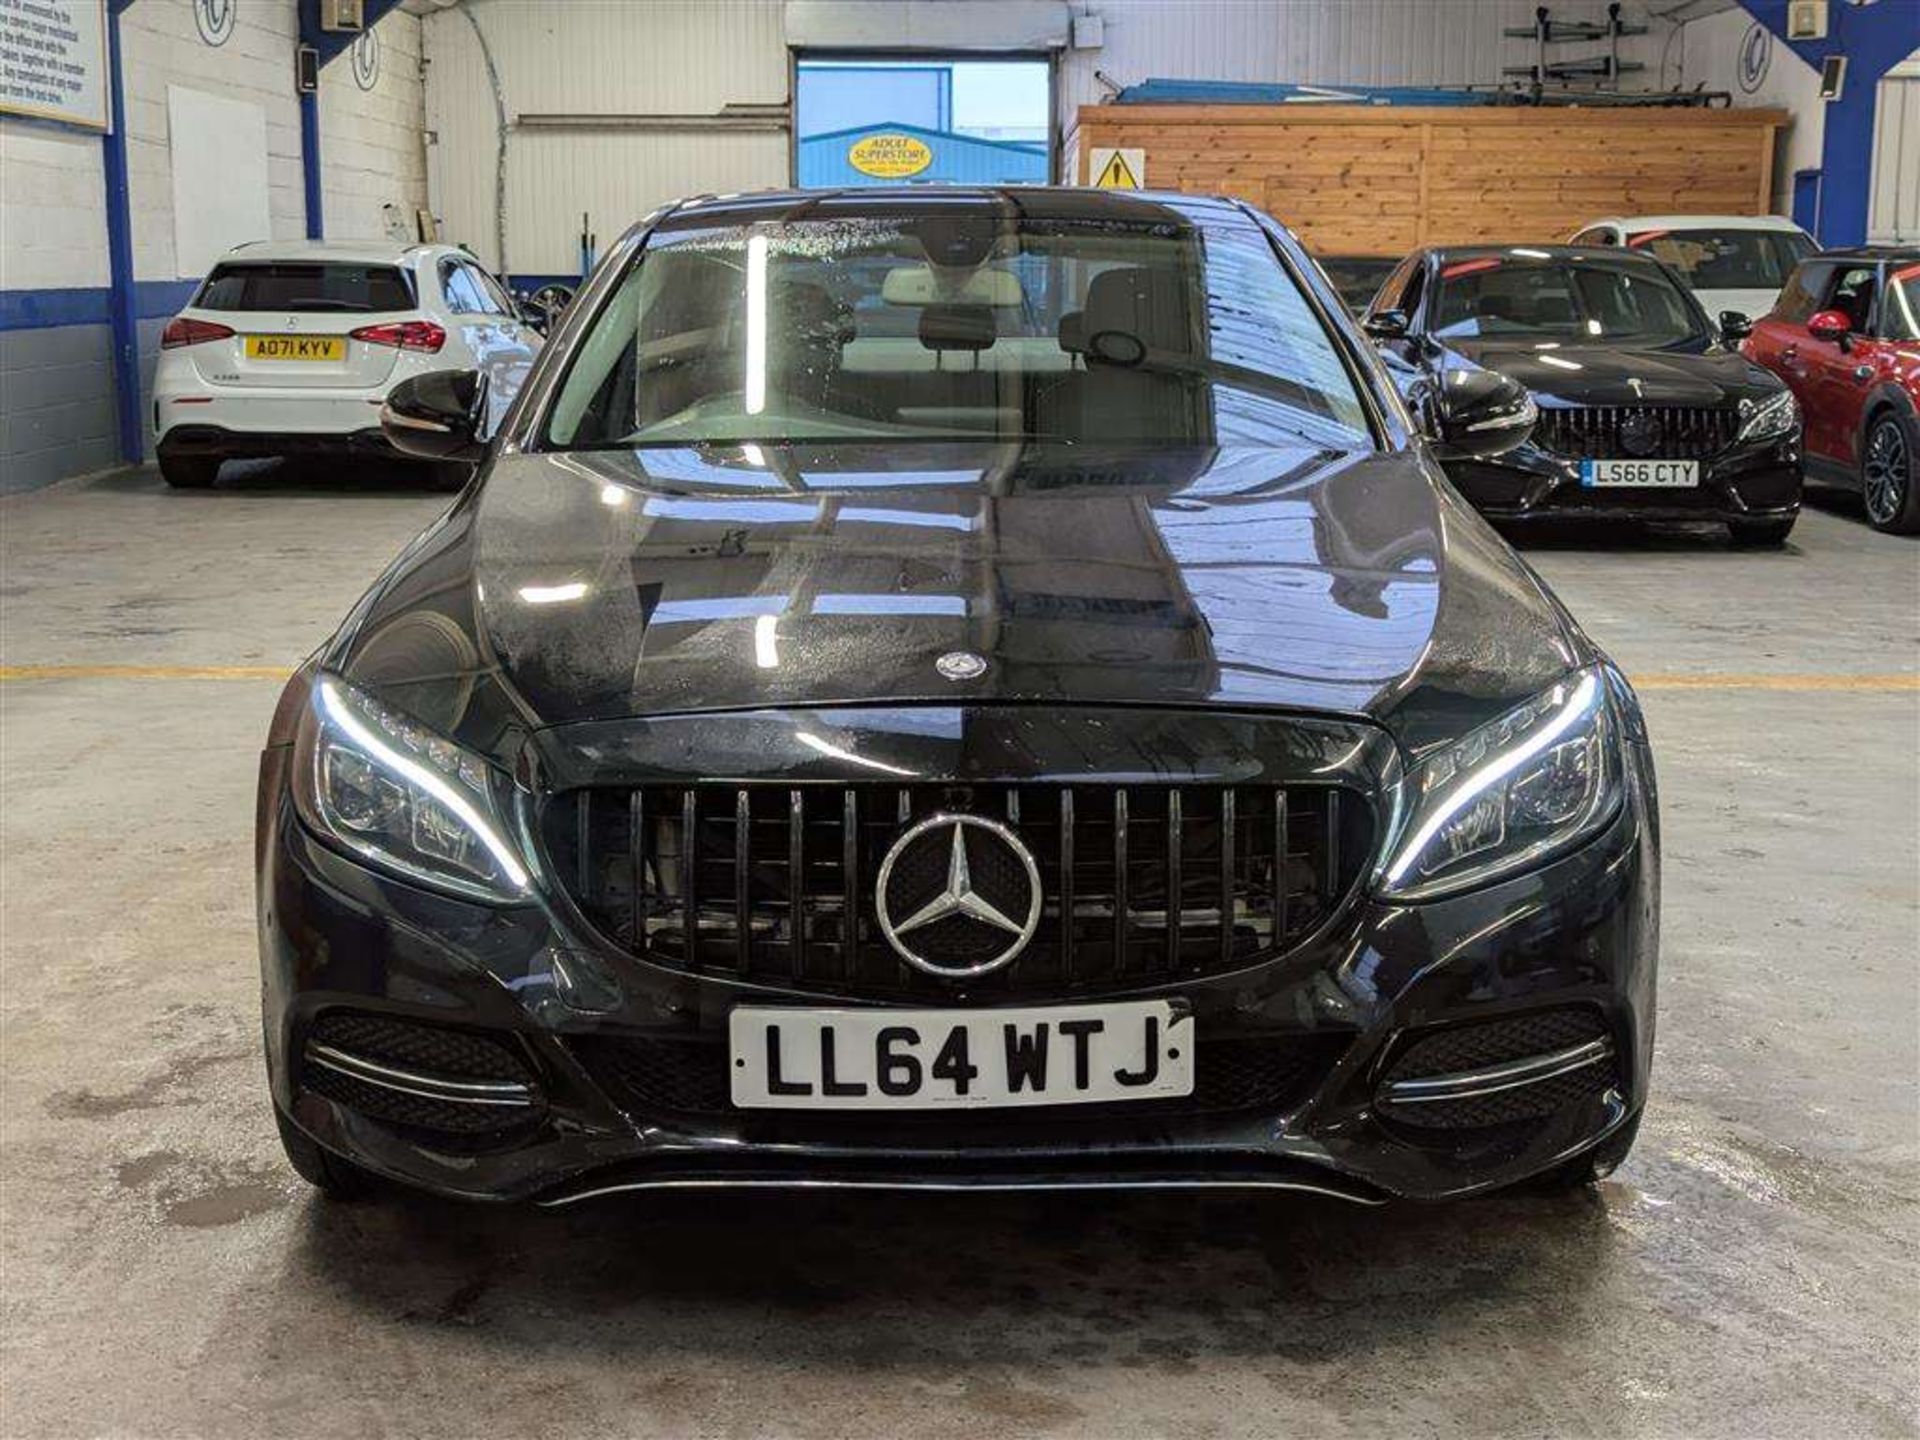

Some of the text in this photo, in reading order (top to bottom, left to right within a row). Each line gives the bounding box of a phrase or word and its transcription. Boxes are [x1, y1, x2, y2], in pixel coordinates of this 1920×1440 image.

[871, 138, 909, 148] ADULT
[853, 149, 926, 160] SUPERSTORE
[299, 341, 332, 356] KYV
[1597, 464, 1649, 482] LS66
[1655, 464, 1694, 482] CTY
[766, 1016, 1159, 1096] LL64 WTJ
